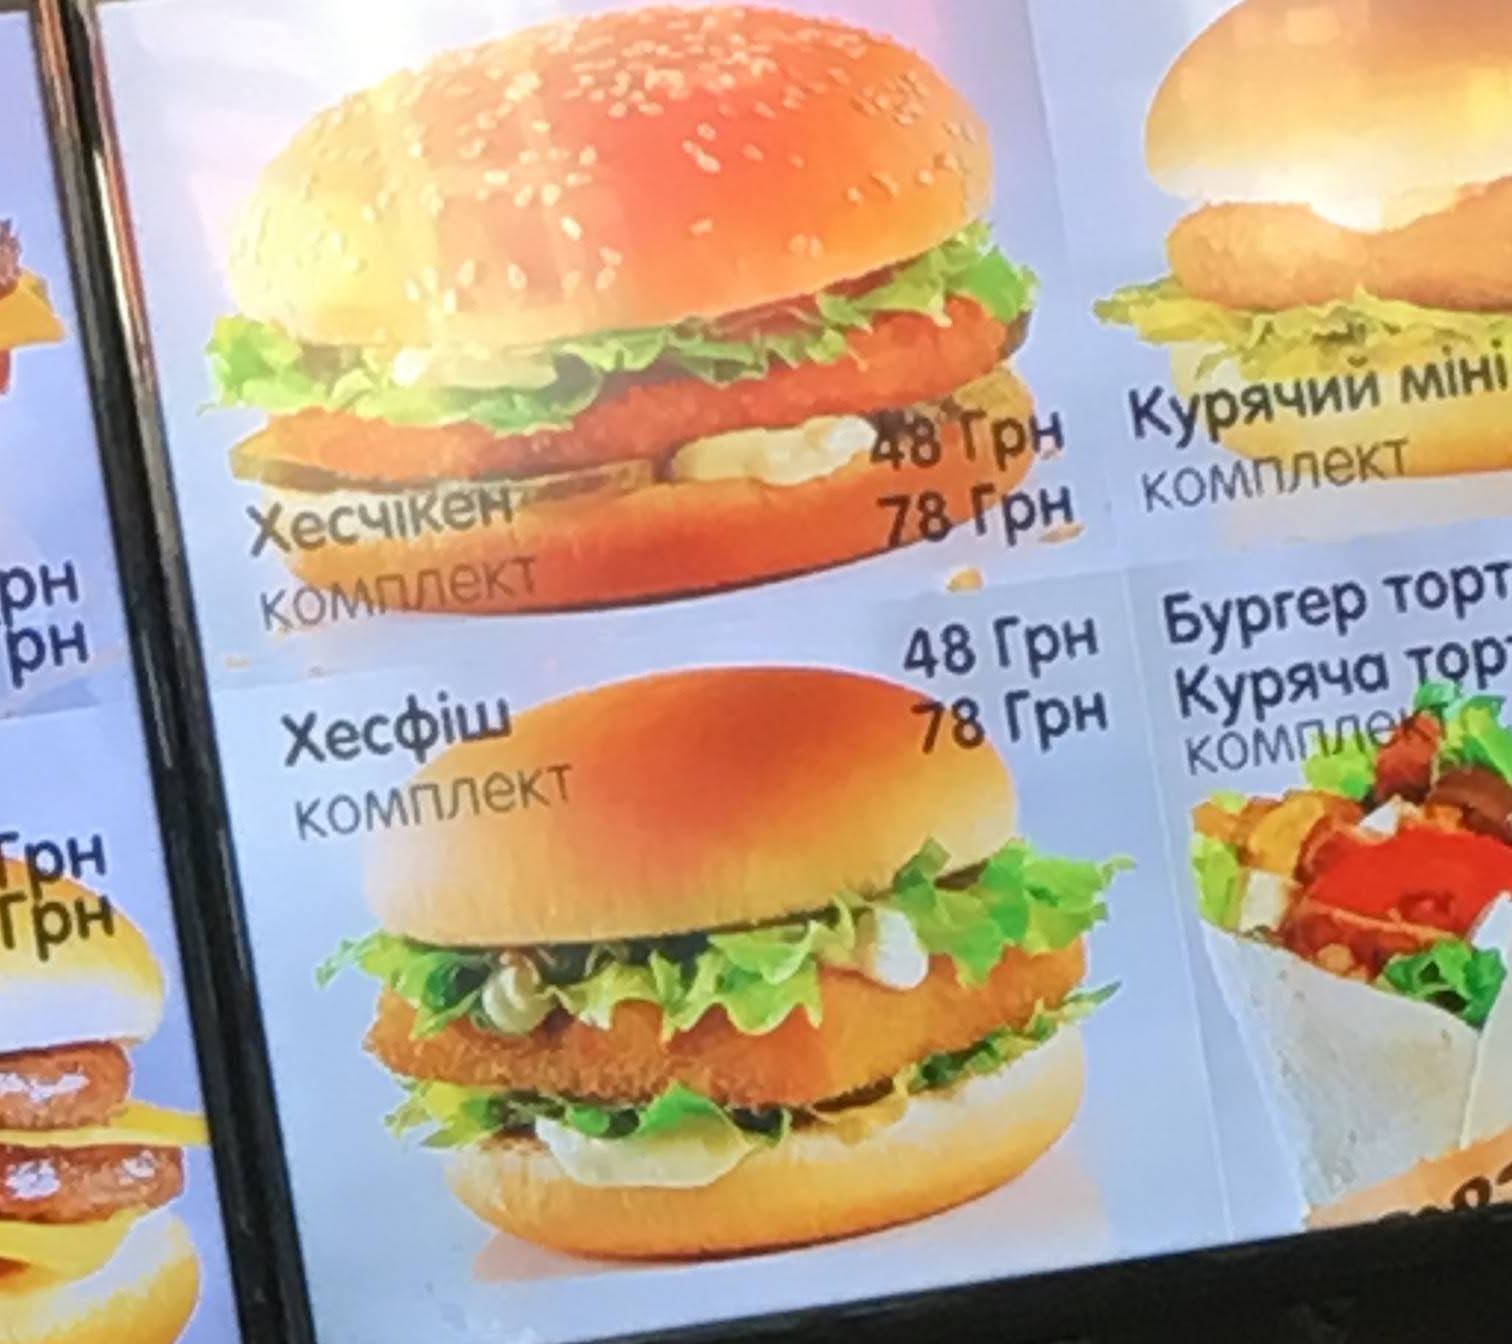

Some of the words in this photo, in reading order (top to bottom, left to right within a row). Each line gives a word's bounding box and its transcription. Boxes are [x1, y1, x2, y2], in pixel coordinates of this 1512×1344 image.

[1128, 355, 1381, 449] Курячий
[1399, 339, 1509, 403] міні
[246, 481, 517, 558] Хесчікен
[868, 414, 943, 472] 48
[959, 407, 1066, 470] Грн
[1141, 437, 1410, 512] комплект
[258, 554, 539, 634] комплект
[876, 492, 955, 549] 78
[968, 479, 1076, 549] Грн
[1162, 579, 1368, 654] Бургер
[280, 691, 513, 769] Хесфіш
[902, 621, 976, 678] 48
[992, 613, 1100, 683] Грн
[1175, 652, 1390, 728] Куряча
[1403, 634, 1512, 690] тор
[295, 763, 574, 841] комплект
[911, 700, 986, 755] 78
[1004, 689, 1108, 758] Грн
